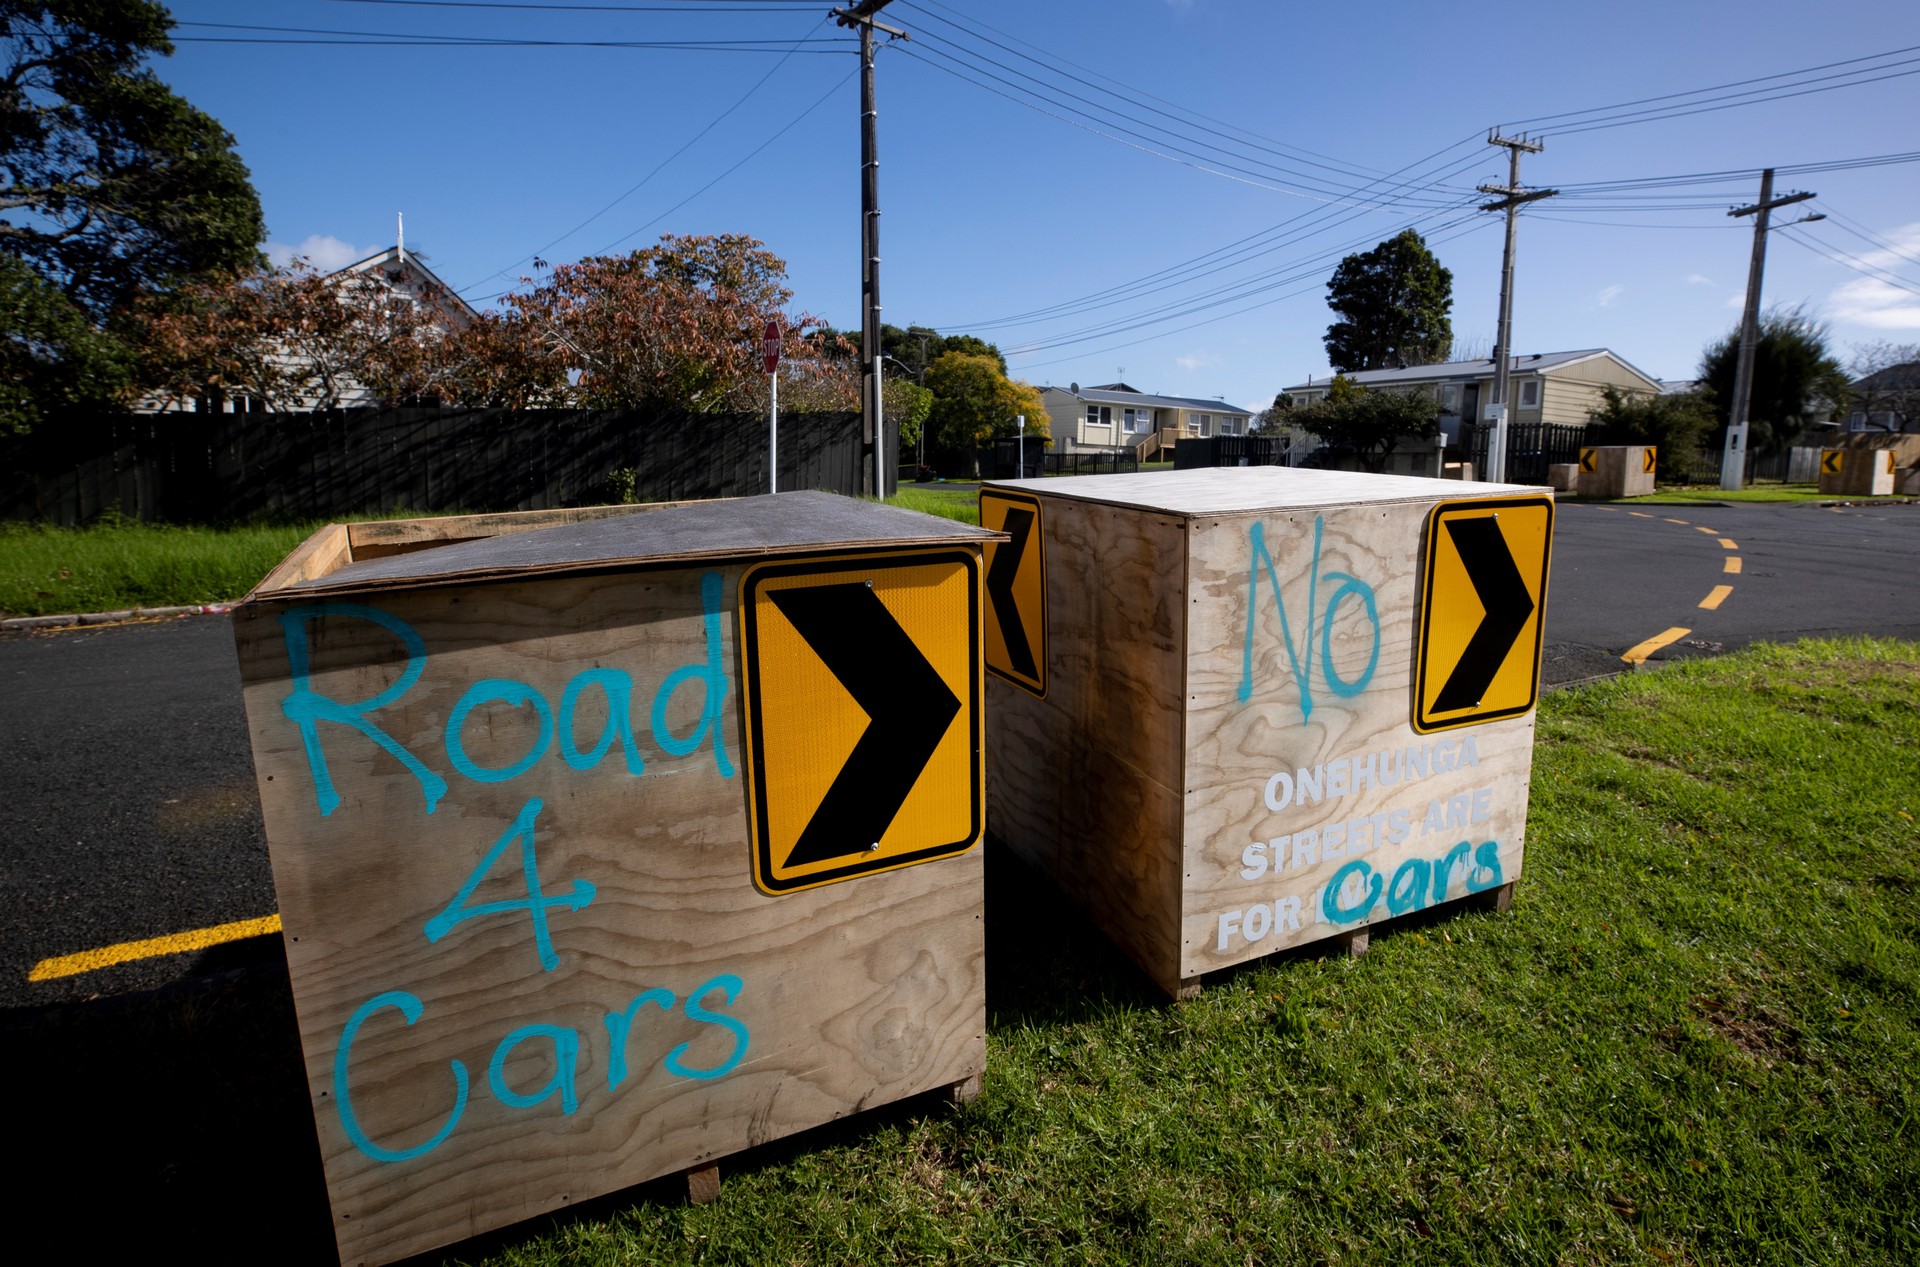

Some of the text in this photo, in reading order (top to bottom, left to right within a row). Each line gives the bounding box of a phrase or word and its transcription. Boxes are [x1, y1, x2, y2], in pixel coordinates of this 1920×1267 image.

[763, 338, 780, 357] STOP
[1237, 515, 1381, 727] No
[278, 571, 736, 817] Road
[1240, 788, 1493, 881] STREETS ARE
[1264, 734, 1480, 812] ONEHUNGA
[423, 796, 598, 972] 4
[1217, 894, 1301, 951] FOR
[334, 974, 750, 1163] Cars
